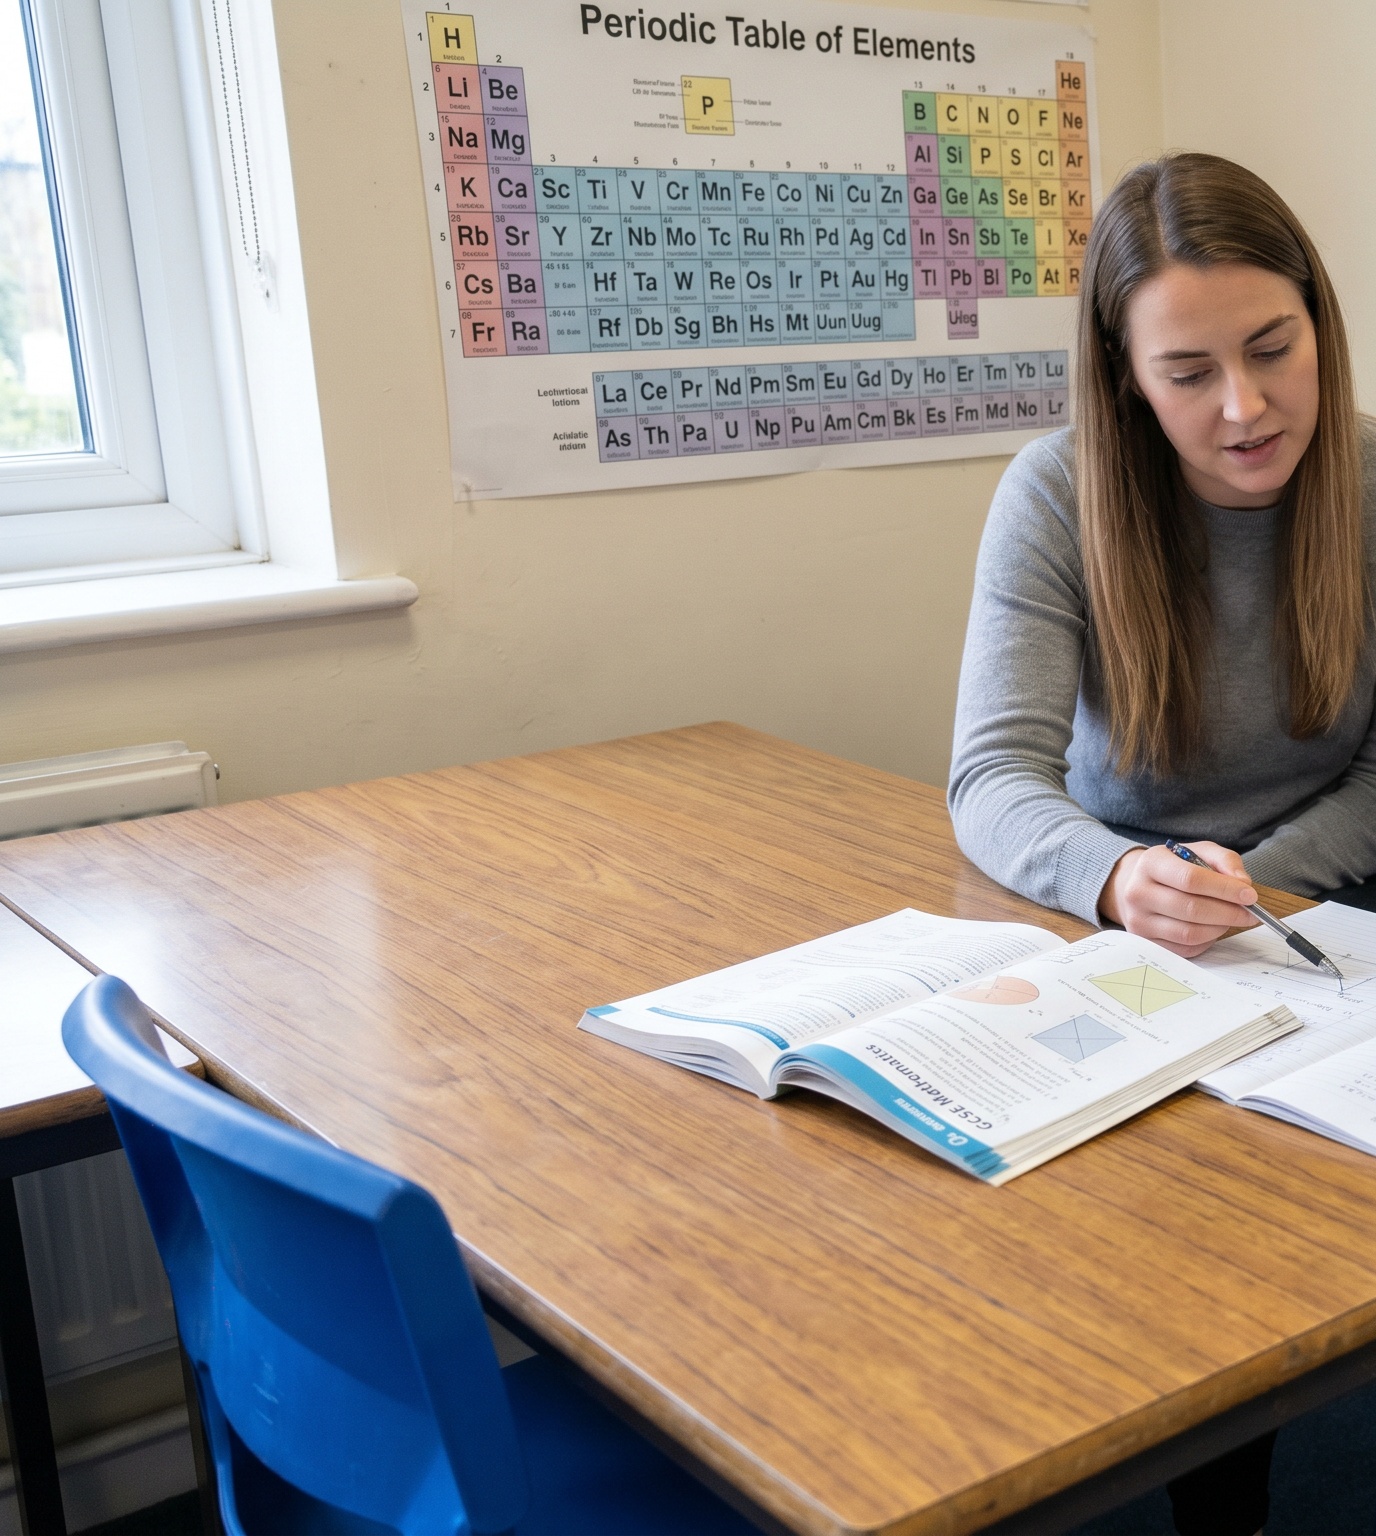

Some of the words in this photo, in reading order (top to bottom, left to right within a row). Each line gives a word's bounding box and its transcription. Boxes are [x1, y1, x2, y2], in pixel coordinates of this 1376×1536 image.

[581, 4, 716, 44] Periodic
[726, 16, 805, 51] Table
[816, 26, 843, 53] of
[854, 27, 975, 63] Elements
[418, 33, 422, 41] 1
[444, 28, 460, 48] H
[1061, 72, 1080, 89] He
[496, 55, 501, 63] 2
[684, 80, 692, 88] 22
[423, 82, 429, 91] 2
[448, 77, 468, 97] Li
[489, 79, 518, 100] Be
[914, 103, 926, 120] B
[947, 105, 957, 122] C
[978, 107, 988, 123] N
[1007, 109, 1019, 125] O
[1039, 110, 1048, 126] F
[1063, 112, 1082, 129] Ne
[702, 96, 713, 115] P
[441, 115, 449, 123] 15
[429, 132, 434, 141] 3
[448, 127, 478, 148] Na
[491, 129, 524, 155] Mg
[915, 145, 930, 162] Al
[947, 146, 962, 163] Si
[981, 148, 990, 164] P
[1011, 149, 1021, 165] S
[1038, 150, 1053, 166] Cl
[1066, 151, 1083, 167] Ar
[550, 154, 555, 162] 3
[435, 184, 440, 192] 4
[461, 177, 477, 197] K
[498, 178, 527, 198] Ca
[542, 178, 570, 198] Sc
[587, 180, 606, 199] Ti
[631, 181, 644, 199] V
[667, 181, 689, 200] Cr
[702, 182, 731, 200] Mn
[742, 183, 765, 201] Fe
[777, 184, 801, 202] Co
[816, 185, 833, 202] Ni
[847, 185, 870, 202] Cu
[881, 186, 902, 203] Zn
[914, 187, 936, 204] Ga
[946, 188, 968, 205] Ge
[978, 188, 998, 205] As
[1009, 189, 1027, 205] Se
[1039, 190, 1056, 206] Br
[1069, 191, 1085, 206] Kr
[441, 233, 446, 241] 5
[458, 226, 488, 246] Rb
[505, 226, 529, 246] Sr
[552, 226, 566, 245] Y
[591, 227, 612, 246] Zr
[628, 227, 656, 246] Nb
[667, 227, 696, 246] Mo
[708, 228, 731, 246] Tc
[744, 228, 768, 246] Ru
[780, 228, 804, 245] Rh
[816, 228, 838, 245] Pd
[850, 228, 873, 250] Ag
[884, 228, 906, 245] Cd
[920, 228, 935, 245] In
[949, 228, 969, 245] Sn
[980, 228, 1000, 245] Sb
[1011, 229, 1028, 245] Te
[1068, 230, 1087, 245] Xe
[446, 281, 451, 290] 6
[464, 274, 493, 294] Cs
[507, 274, 536, 293] Ba
[594, 272, 616, 291] Hf
[634, 272, 657, 291] Ta
[674, 272, 693, 290] W
[710, 271, 735, 289] Re
[746, 271, 772, 289] Os
[790, 271, 802, 288] Ir
[821, 271, 839, 288] Pt
[852, 270, 874, 287] Au
[886, 270, 908, 291] Hg
[921, 269, 936, 286] Tl
[951, 269, 972, 285] Pb
[1012, 269, 1031, 284] Po
[1044, 269, 1059, 284] At
[1070, 268, 1079, 283] R
[451, 330, 455, 338] 7
[472, 322, 495, 342] Fr
[512, 321, 540, 340] Ra
[599, 318, 620, 337] Rf
[636, 317, 663, 336] Db
[675, 317, 700, 339] Sg
[713, 315, 737, 333] Bh
[750, 315, 774, 332] Hs
[787, 314, 809, 331] Mt
[817, 314, 846, 329] Uun
[603, 385, 627, 403] La
[641, 382, 667, 400] Ce
[681, 380, 702, 398] Pr
[716, 377, 741, 396] Nd
[750, 377, 780, 394] Pm
[786, 375, 814, 392] Sm
[824, 373, 846, 389] Eu
[857, 370, 881, 387] Gd
[892, 369, 912, 389] Dy
[924, 368, 945, 384] Ho
[957, 366, 974, 382] Er
[984, 365, 1006, 380] Tm
[1016, 363, 1035, 378] Yb
[1046, 362, 1063, 377] Lu
[644, 426, 669, 444] Th
[683, 424, 707, 442] Pa
[725, 421, 738, 438] U
[756, 419, 780, 440] Np
[792, 417, 814, 433] Pu
[824, 414, 851, 431] Am
[858, 412, 886, 428] Cm
[894, 409, 915, 426] Bk
[927, 408, 946, 424] Es
[956, 406, 978, 422] Fm
[986, 403, 1008, 419] Md
[1017, 401, 1037, 417] No
[1049, 400, 1063, 415] Lr
[949, 1104, 993, 1130] GCSE
